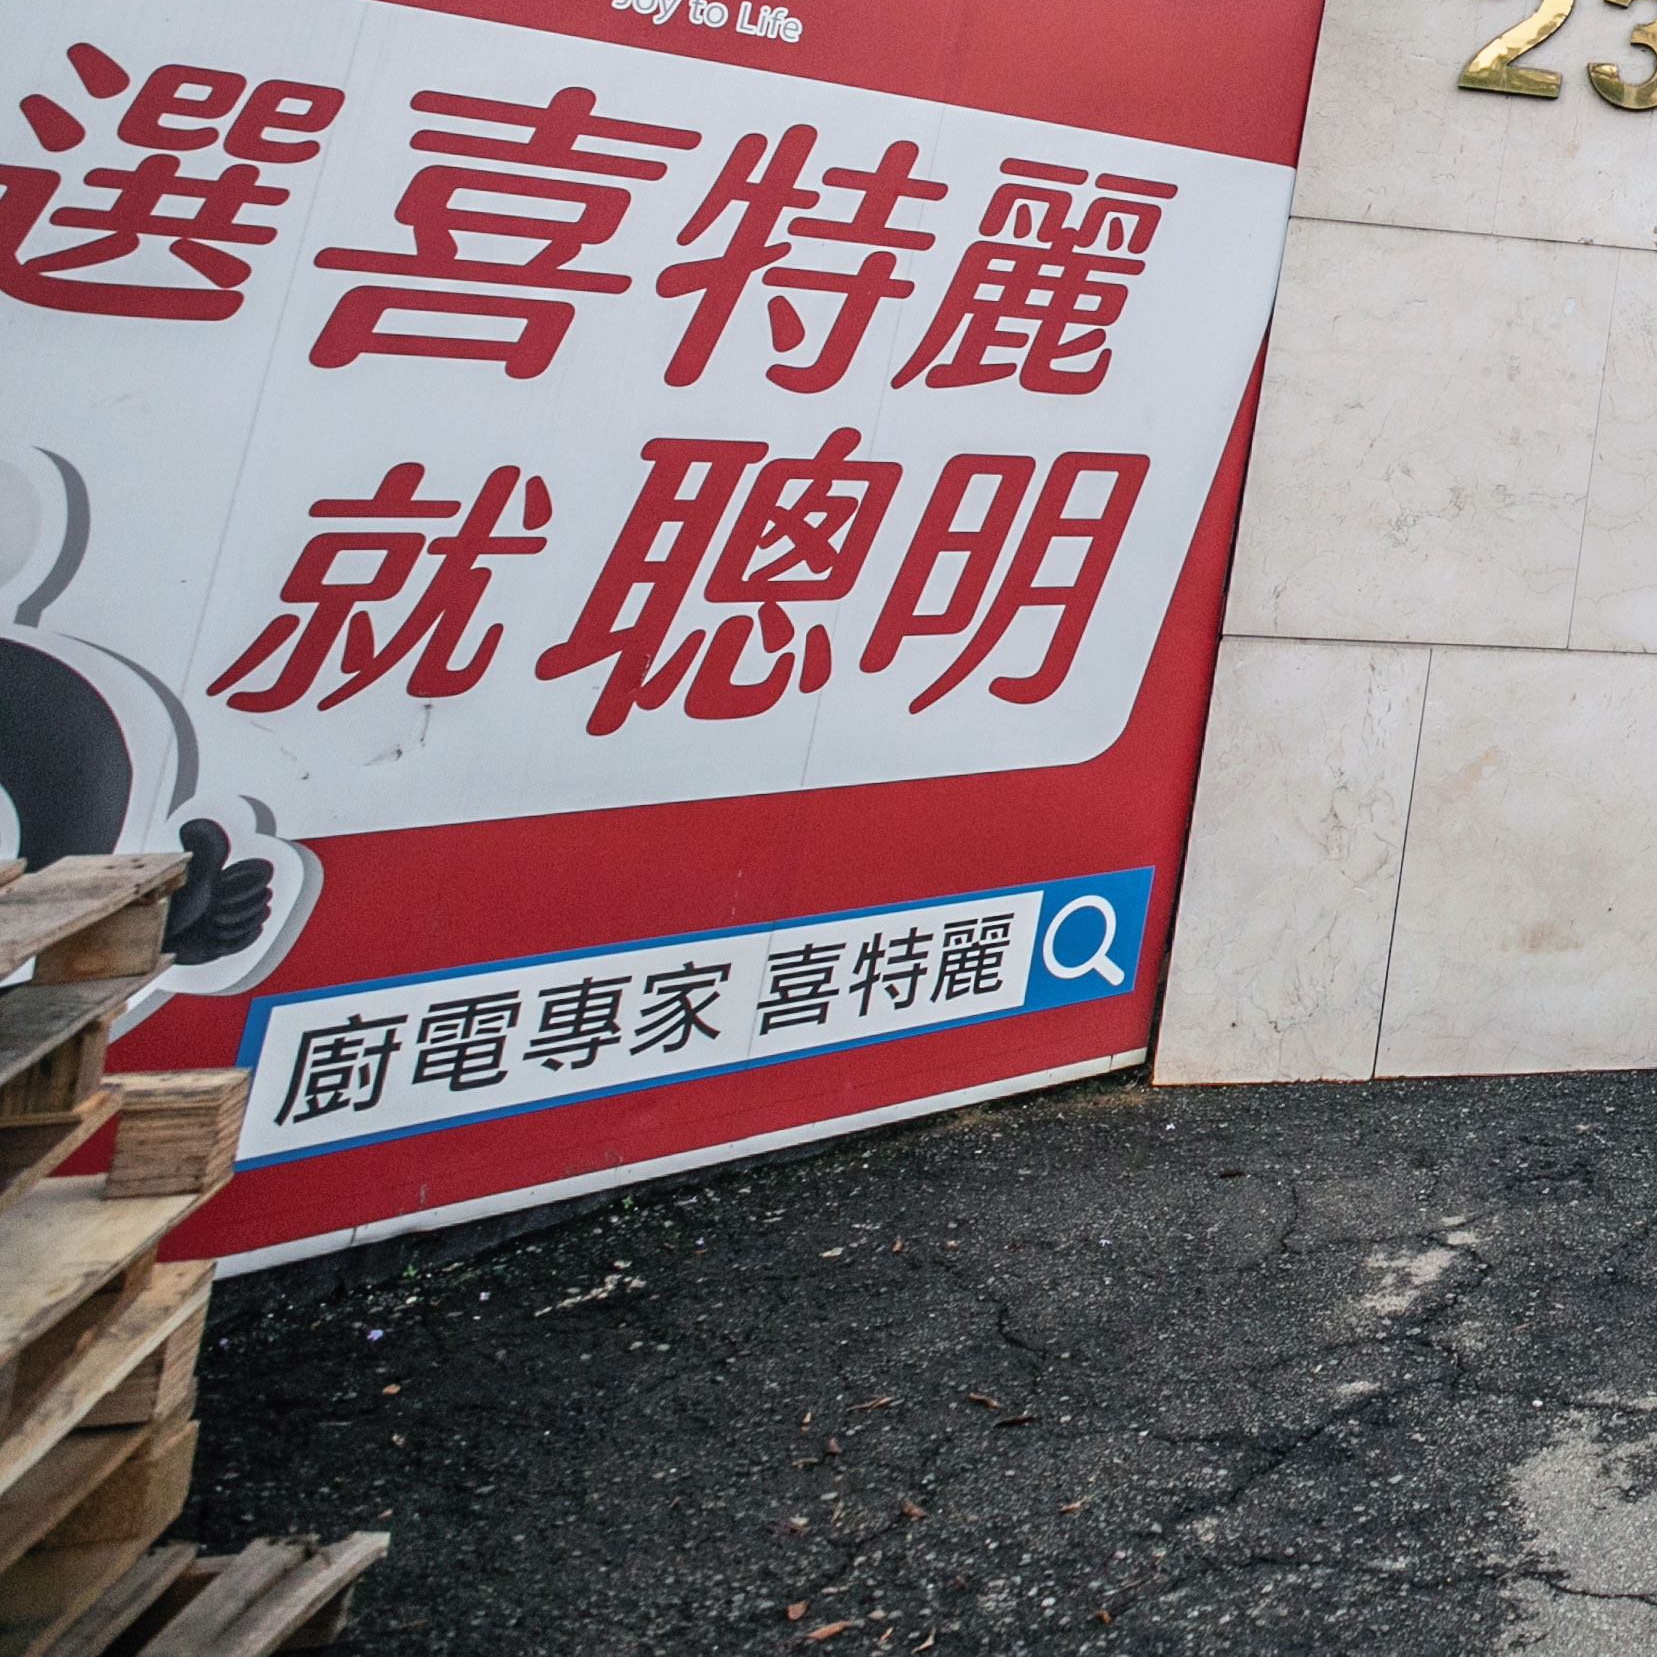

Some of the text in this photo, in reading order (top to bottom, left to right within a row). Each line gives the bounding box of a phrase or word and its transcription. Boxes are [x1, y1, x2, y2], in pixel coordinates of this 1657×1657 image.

[736, 1, 803, 42] Life
[0, 42, 1178, 394] 選喜特麗
[207, 427, 1150, 736] 就聰明
[273, 912, 1016, 1127] 廚電專家 喜特麗
